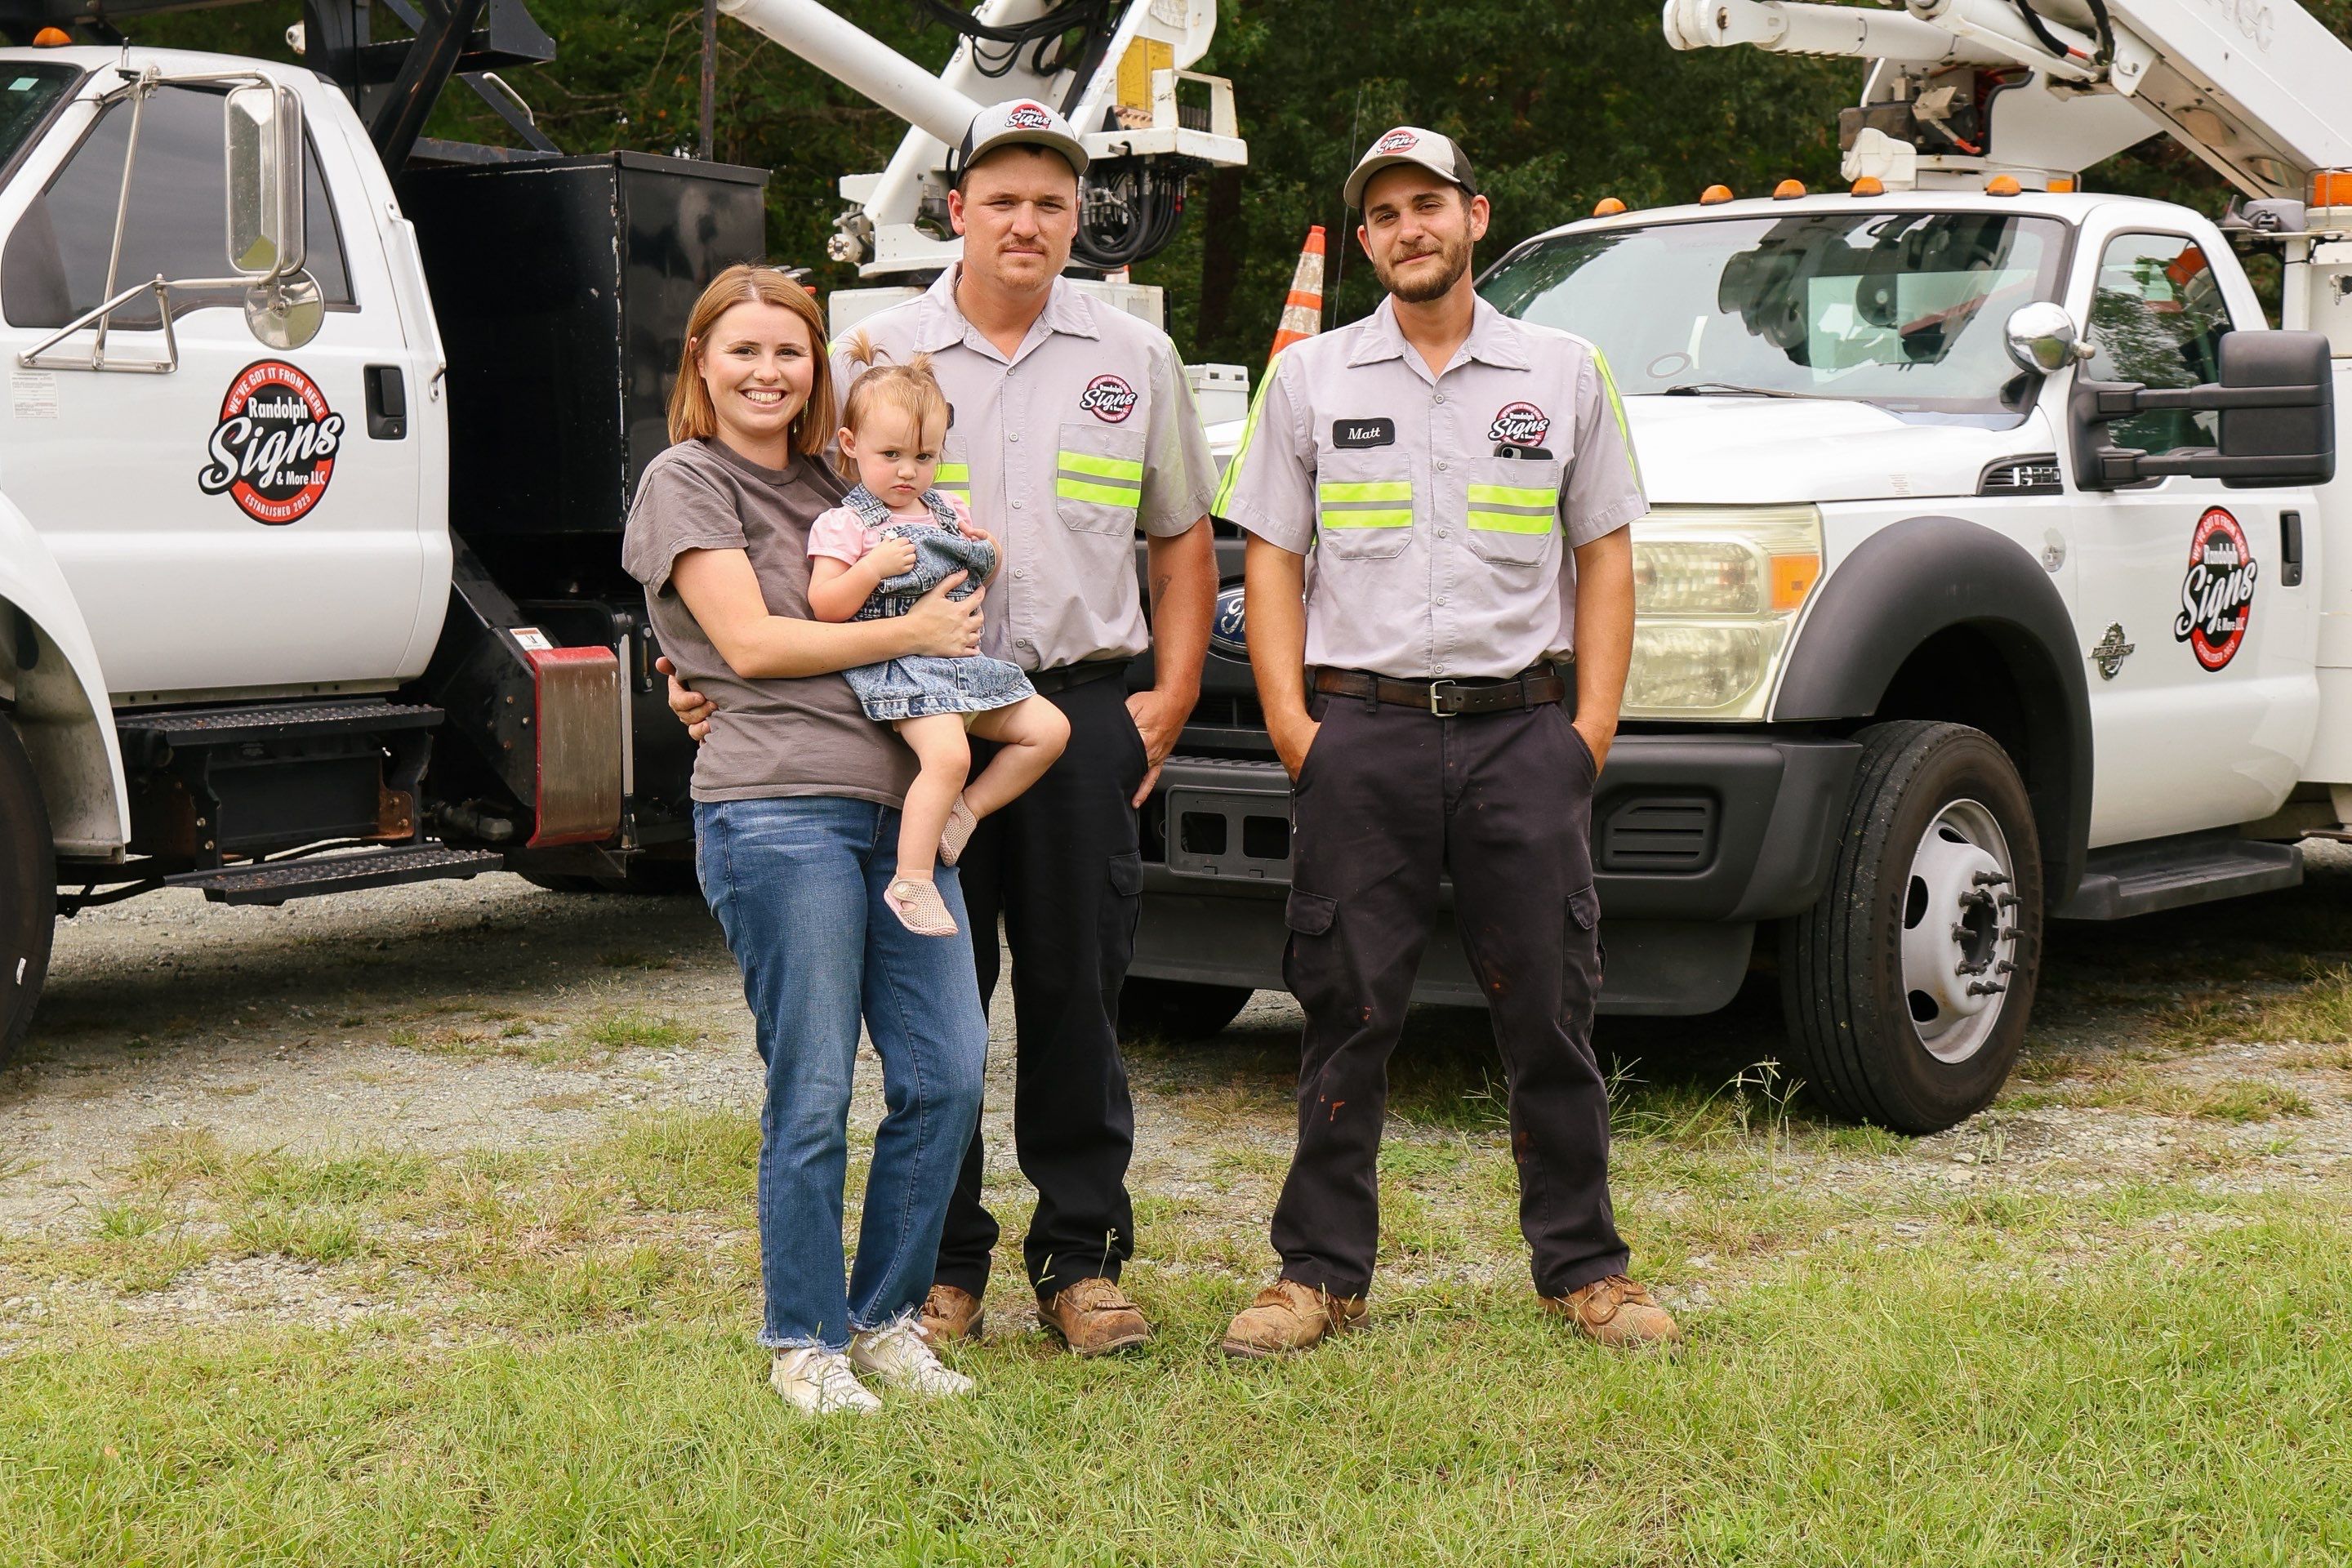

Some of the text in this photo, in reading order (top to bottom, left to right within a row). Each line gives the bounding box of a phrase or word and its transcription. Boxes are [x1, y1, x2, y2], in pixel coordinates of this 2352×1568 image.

[1004, 113, 1051, 127] Signs
[229, 367, 325, 416] WE'VE GOT IT FROM HERE
[1080, 389, 1136, 411] Signs
[248, 396, 308, 425] Randolph
[1348, 427, 1380, 440] Matt
[1489, 417, 1548, 440] Signs
[201, 416, 341, 488] Signs
[276, 470, 326, 485] & More LLC
[245, 492, 311, 517] ESTABLISHED 2025
[2203, 542, 2238, 570] Randolph
[2176, 562, 2256, 635] Signs
